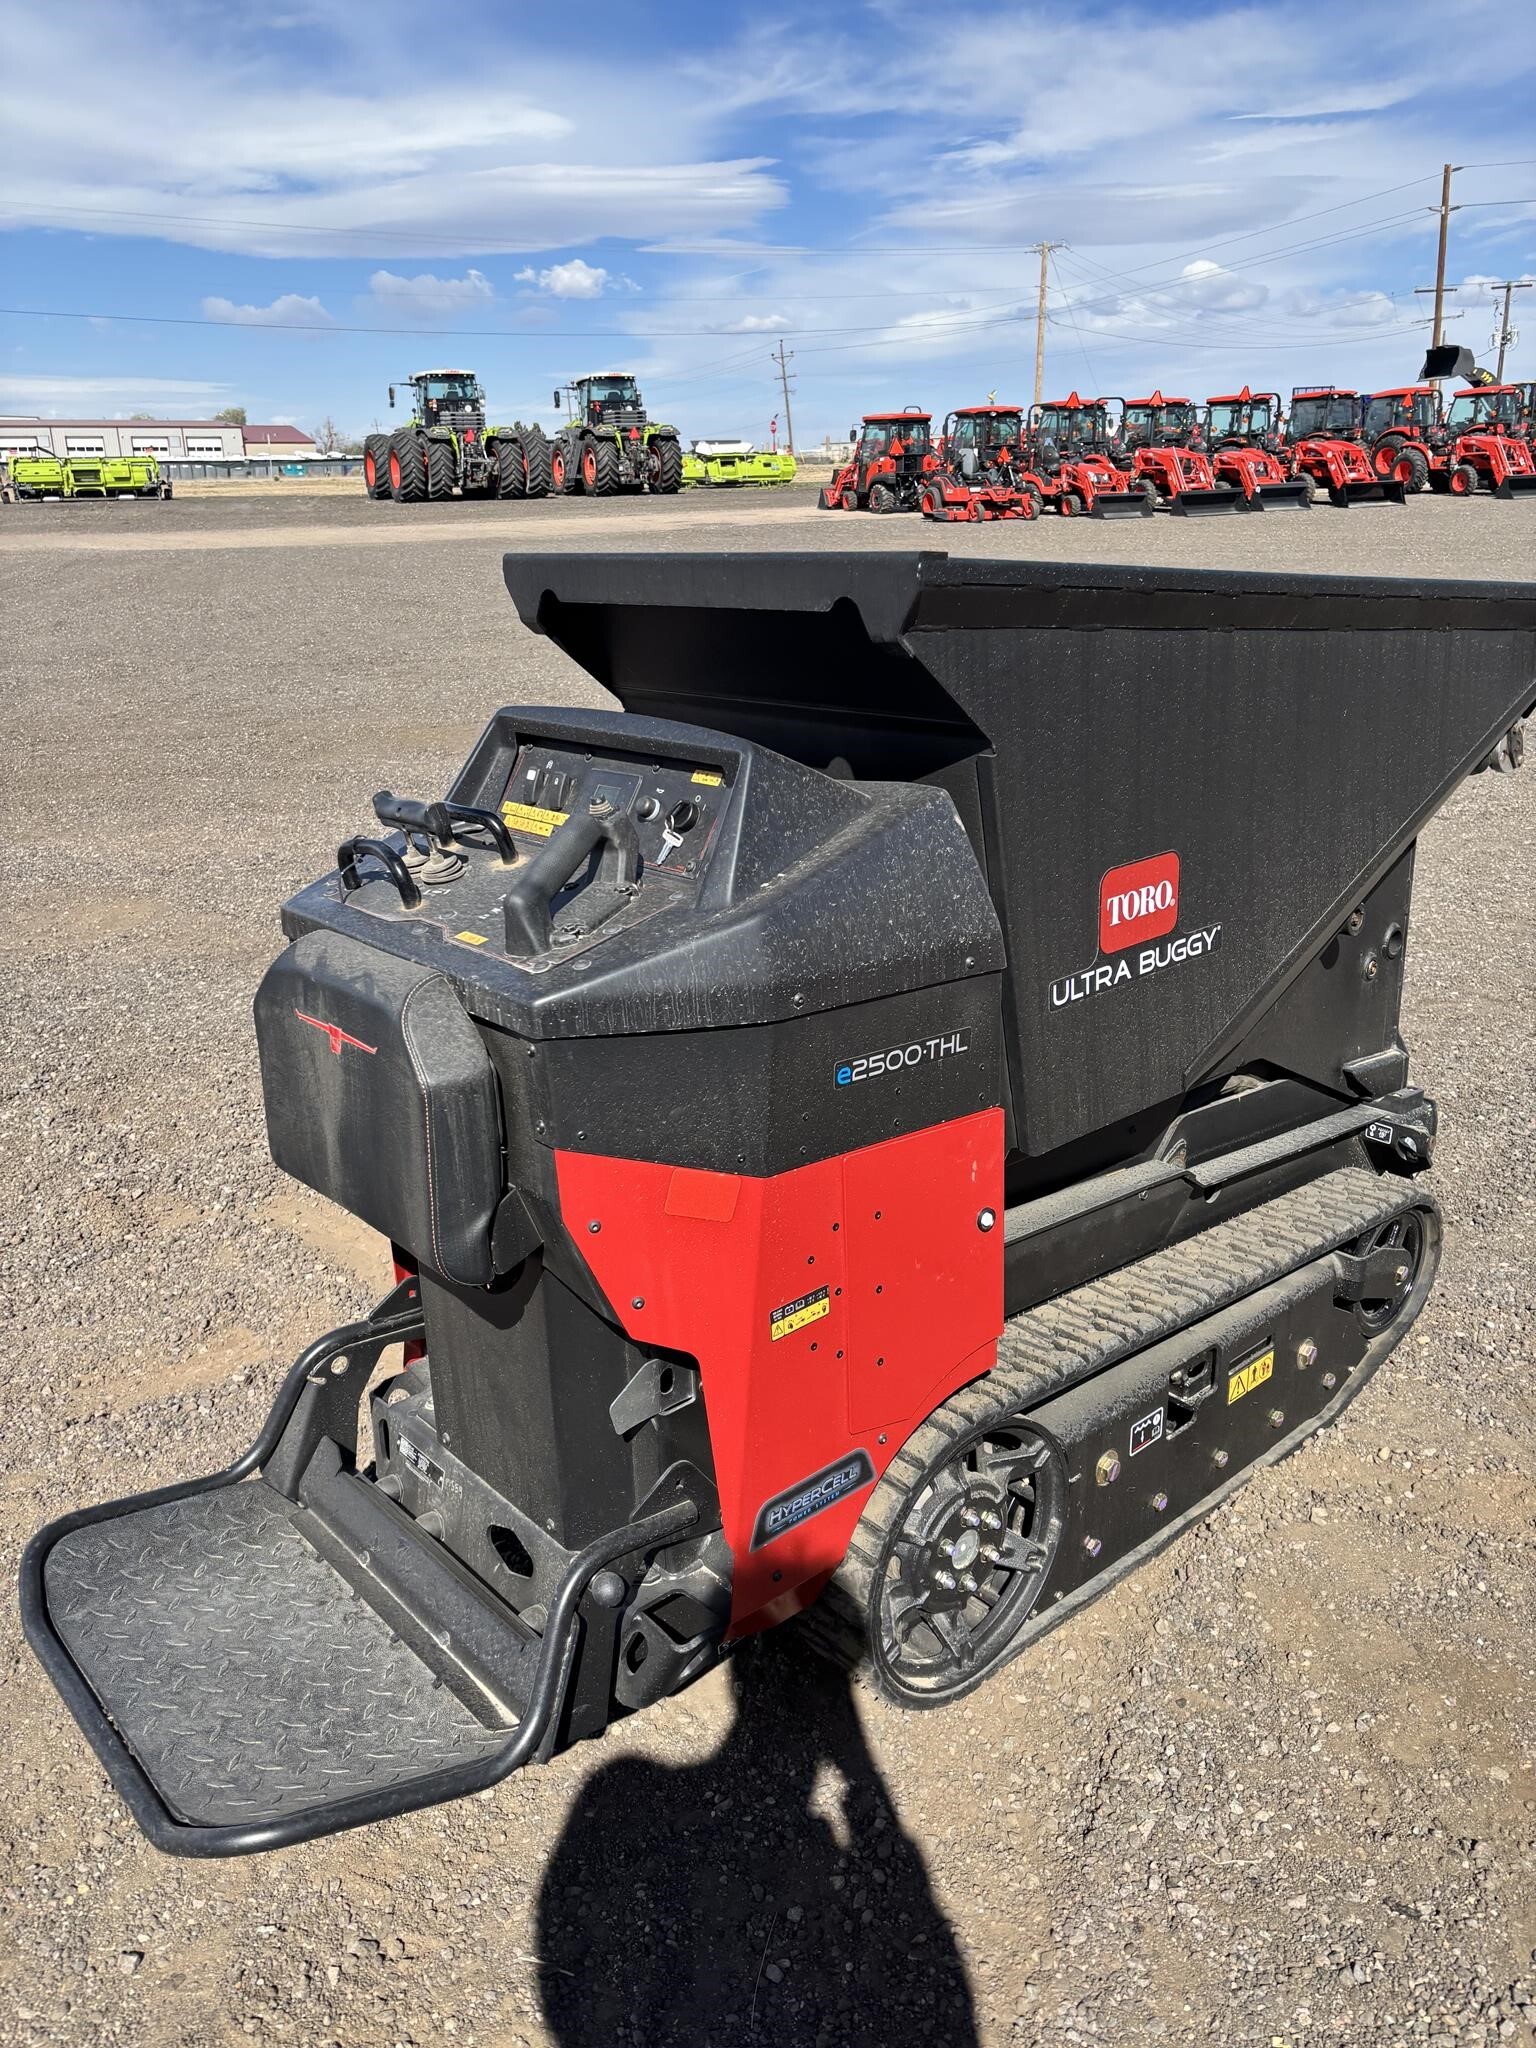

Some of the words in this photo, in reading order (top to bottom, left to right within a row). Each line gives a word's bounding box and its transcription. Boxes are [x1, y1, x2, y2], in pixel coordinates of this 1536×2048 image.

[1106, 880, 1174, 926] TORO
[1052, 959, 1132, 1006] ULTRA
[1139, 929, 1217, 975] BUGGY
